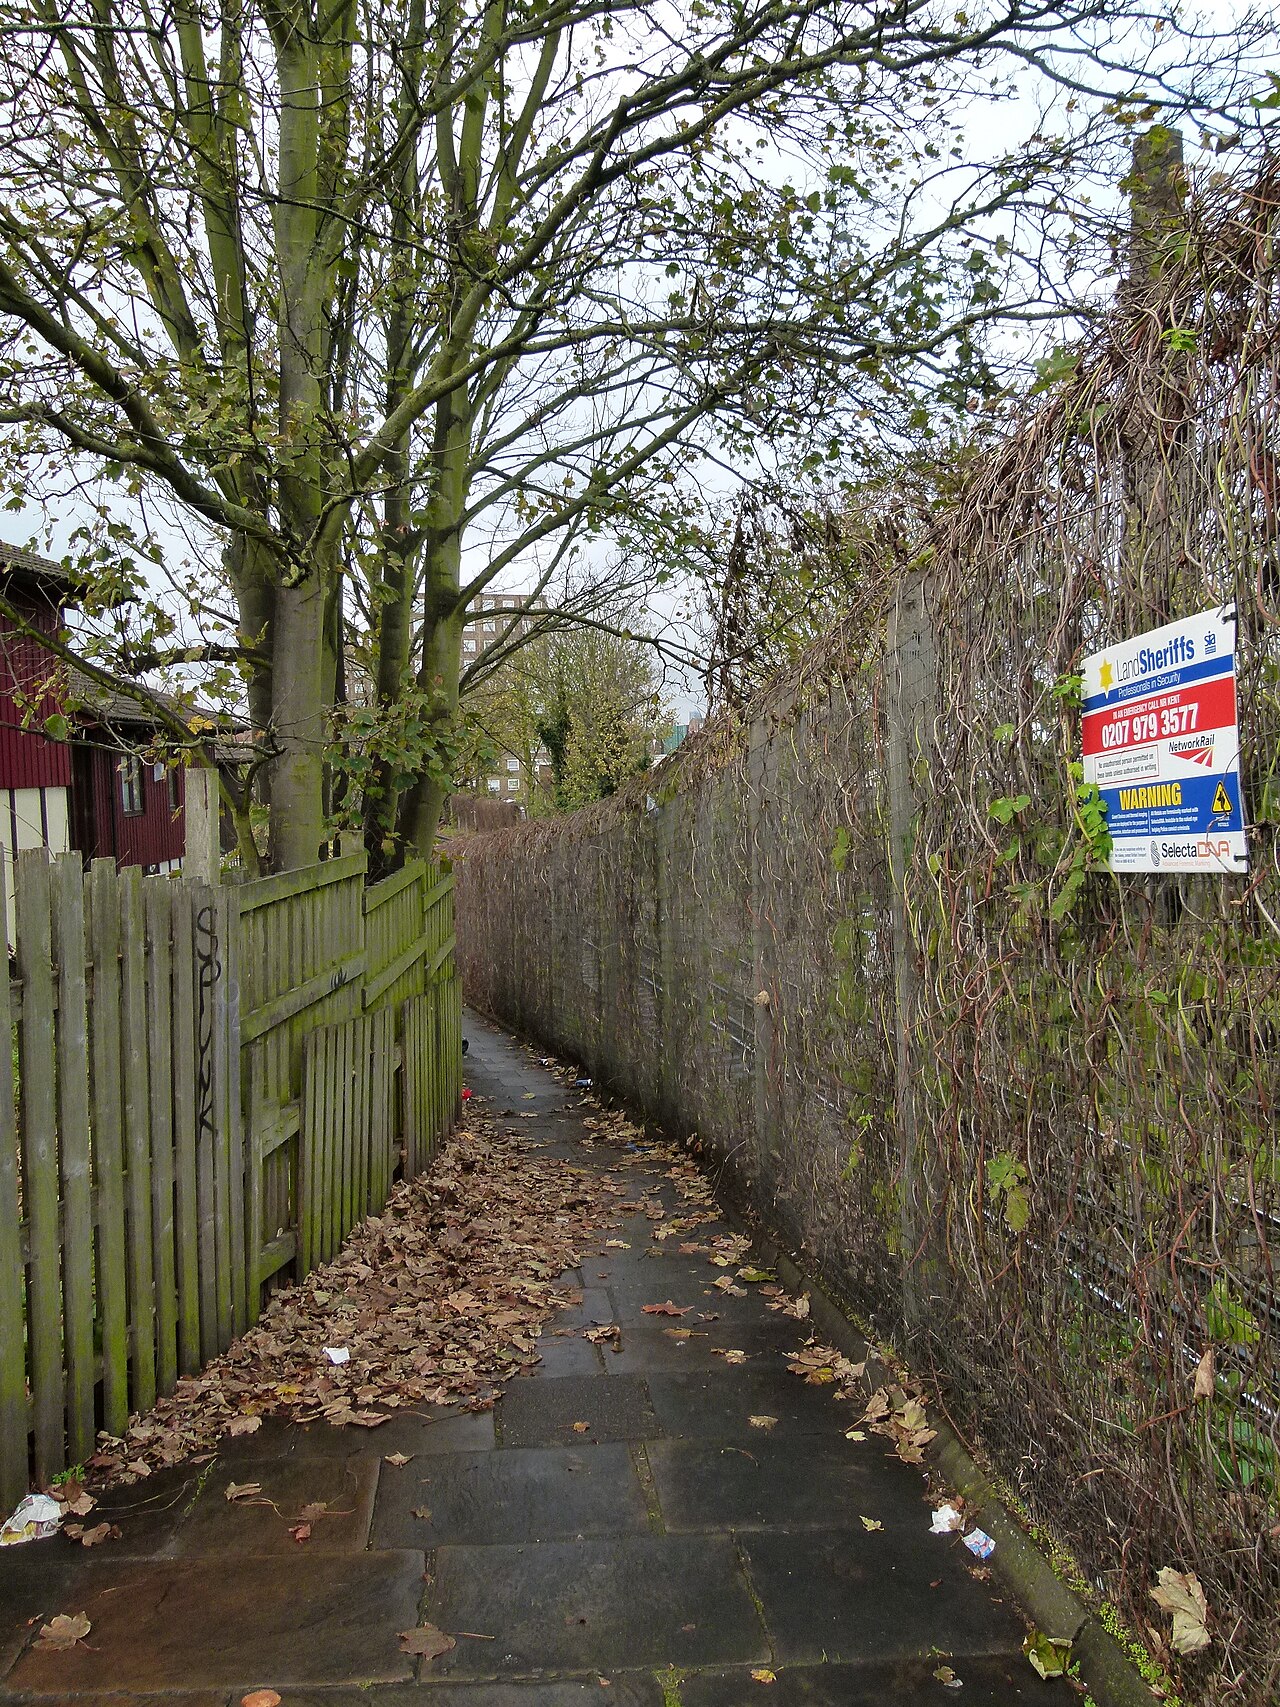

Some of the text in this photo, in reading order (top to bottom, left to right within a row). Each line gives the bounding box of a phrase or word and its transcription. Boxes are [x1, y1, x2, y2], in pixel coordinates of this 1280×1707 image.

[1116, 635, 1195, 682] LandSheriffs
[1118, 673, 1181, 698] Professionals in Security
[1123, 703, 1148, 717] EMERGENCY
[1148, 699, 1159, 711] CALL
[1102, 703, 1199, 749] 0207 979 3577
[1119, 783, 1182, 811] WARNING
